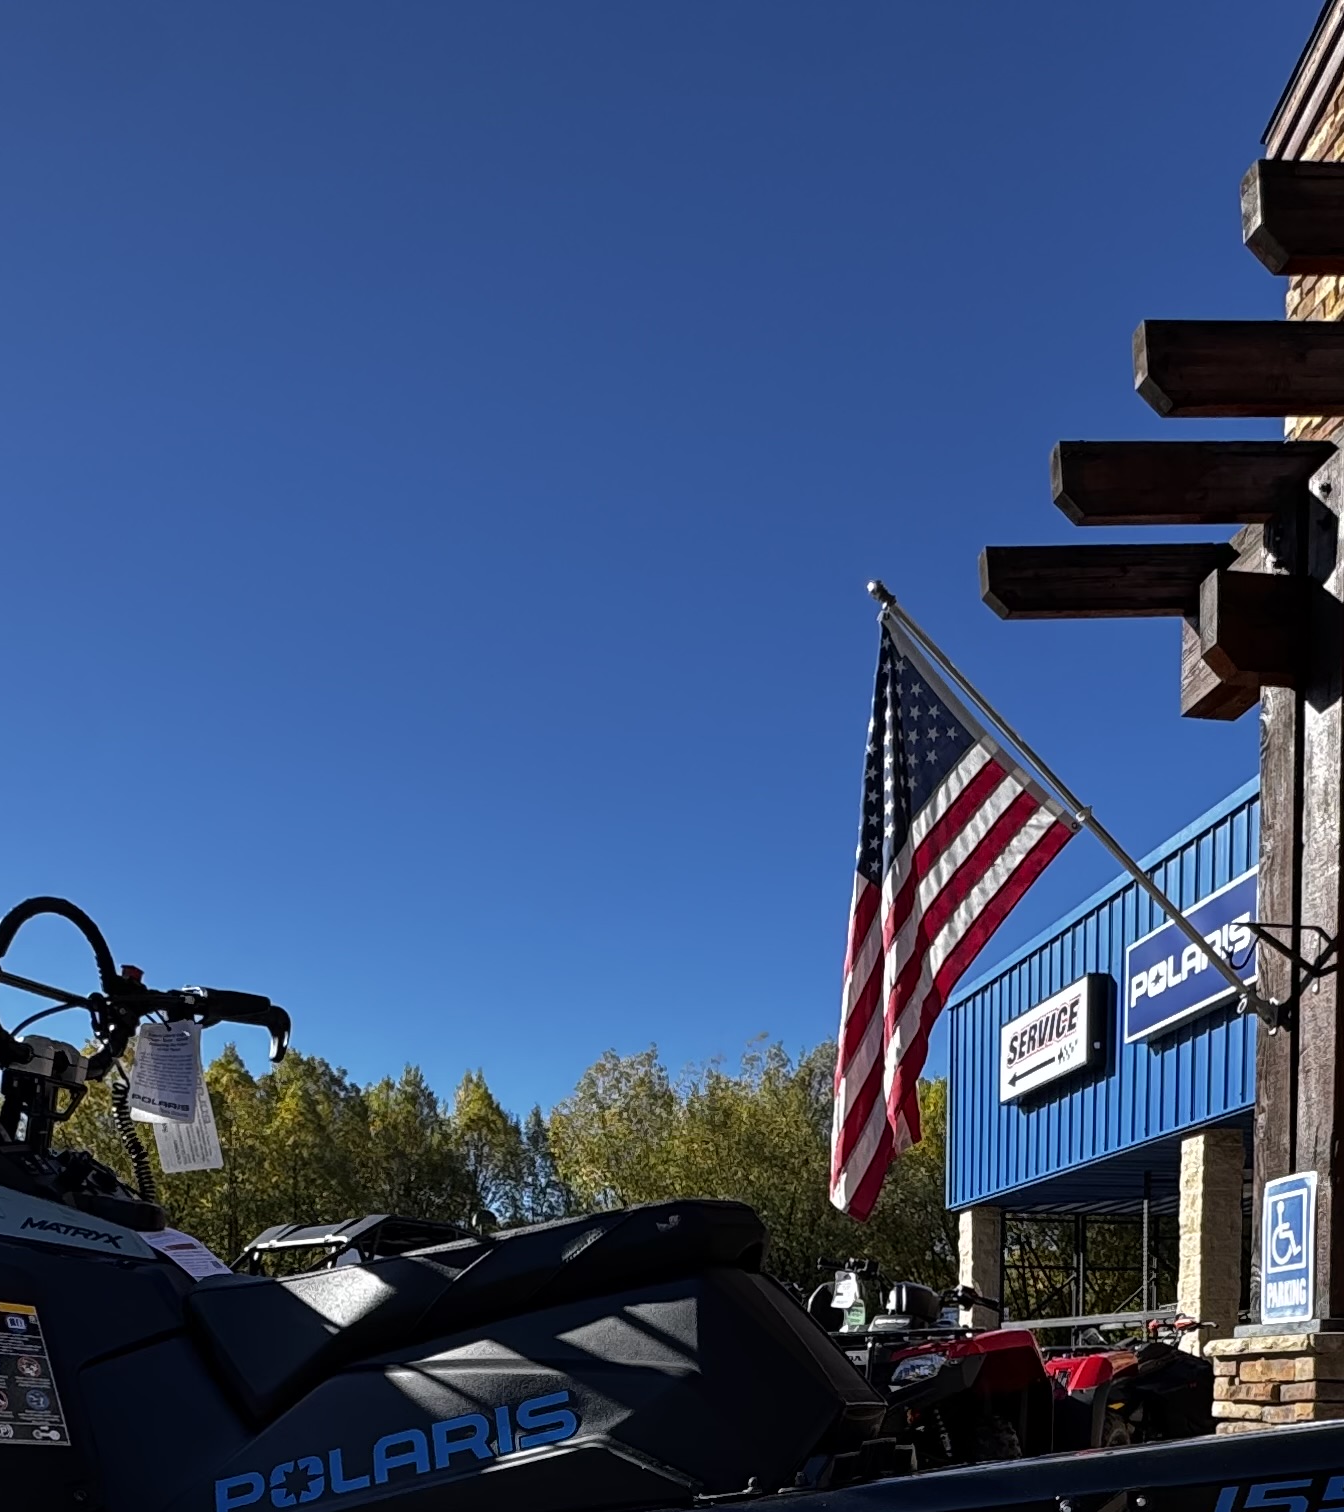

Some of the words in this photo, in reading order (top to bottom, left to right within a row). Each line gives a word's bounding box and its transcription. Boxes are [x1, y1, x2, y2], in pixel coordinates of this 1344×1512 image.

[1131, 912, 1251, 1008] POLARIS
[1007, 996, 1081, 1067] SERVICE
[131, 1093, 190, 1112] POLARIS
[20, 1217, 123, 1249] MATRYX
[1266, 1278, 1307, 1309] PARKING
